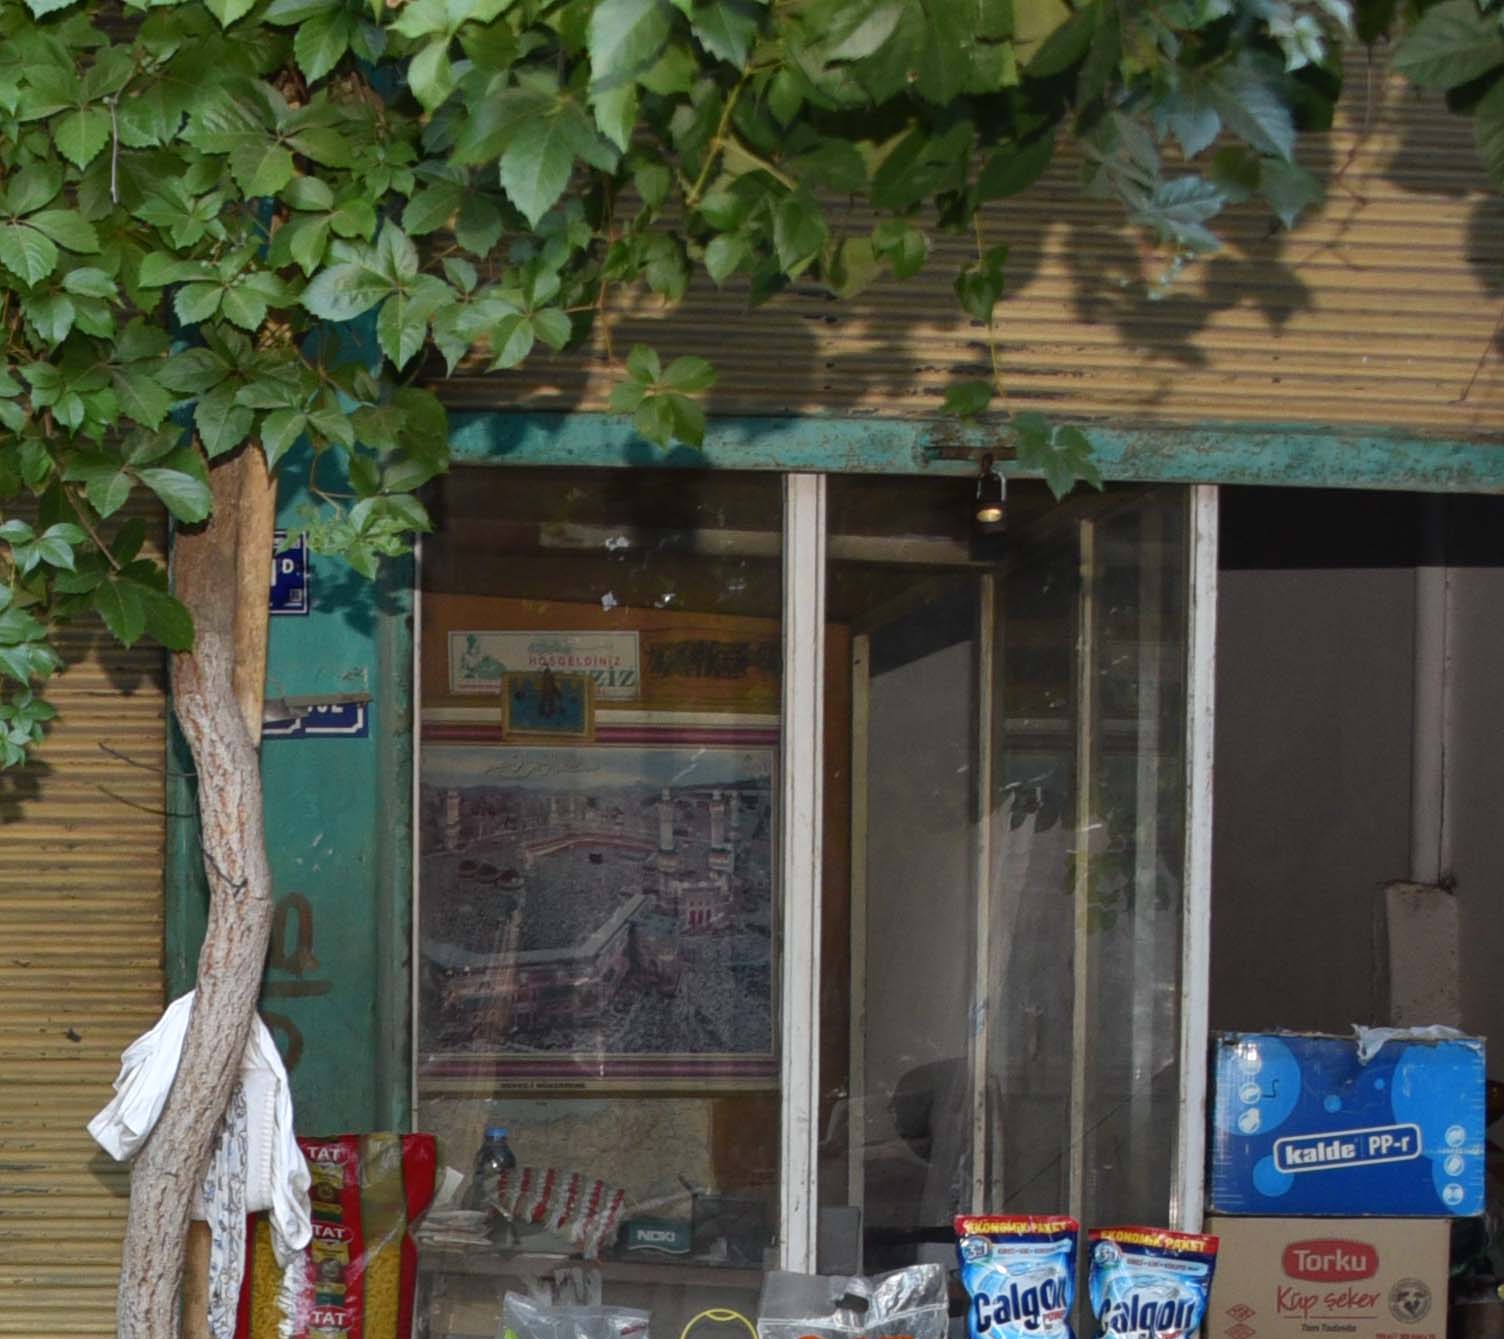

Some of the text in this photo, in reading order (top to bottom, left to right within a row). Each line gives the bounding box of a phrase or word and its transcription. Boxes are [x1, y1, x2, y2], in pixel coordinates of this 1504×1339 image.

[306, 1147, 342, 1161] TAT
[1285, 1134, 1410, 1166] kalde PP-r
[312, 1224, 345, 1239] TAT
[1294, 1248, 1367, 1272] Torku
[974, 1276, 1068, 1333] Calgon
[311, 1310, 347, 1325] TAT
